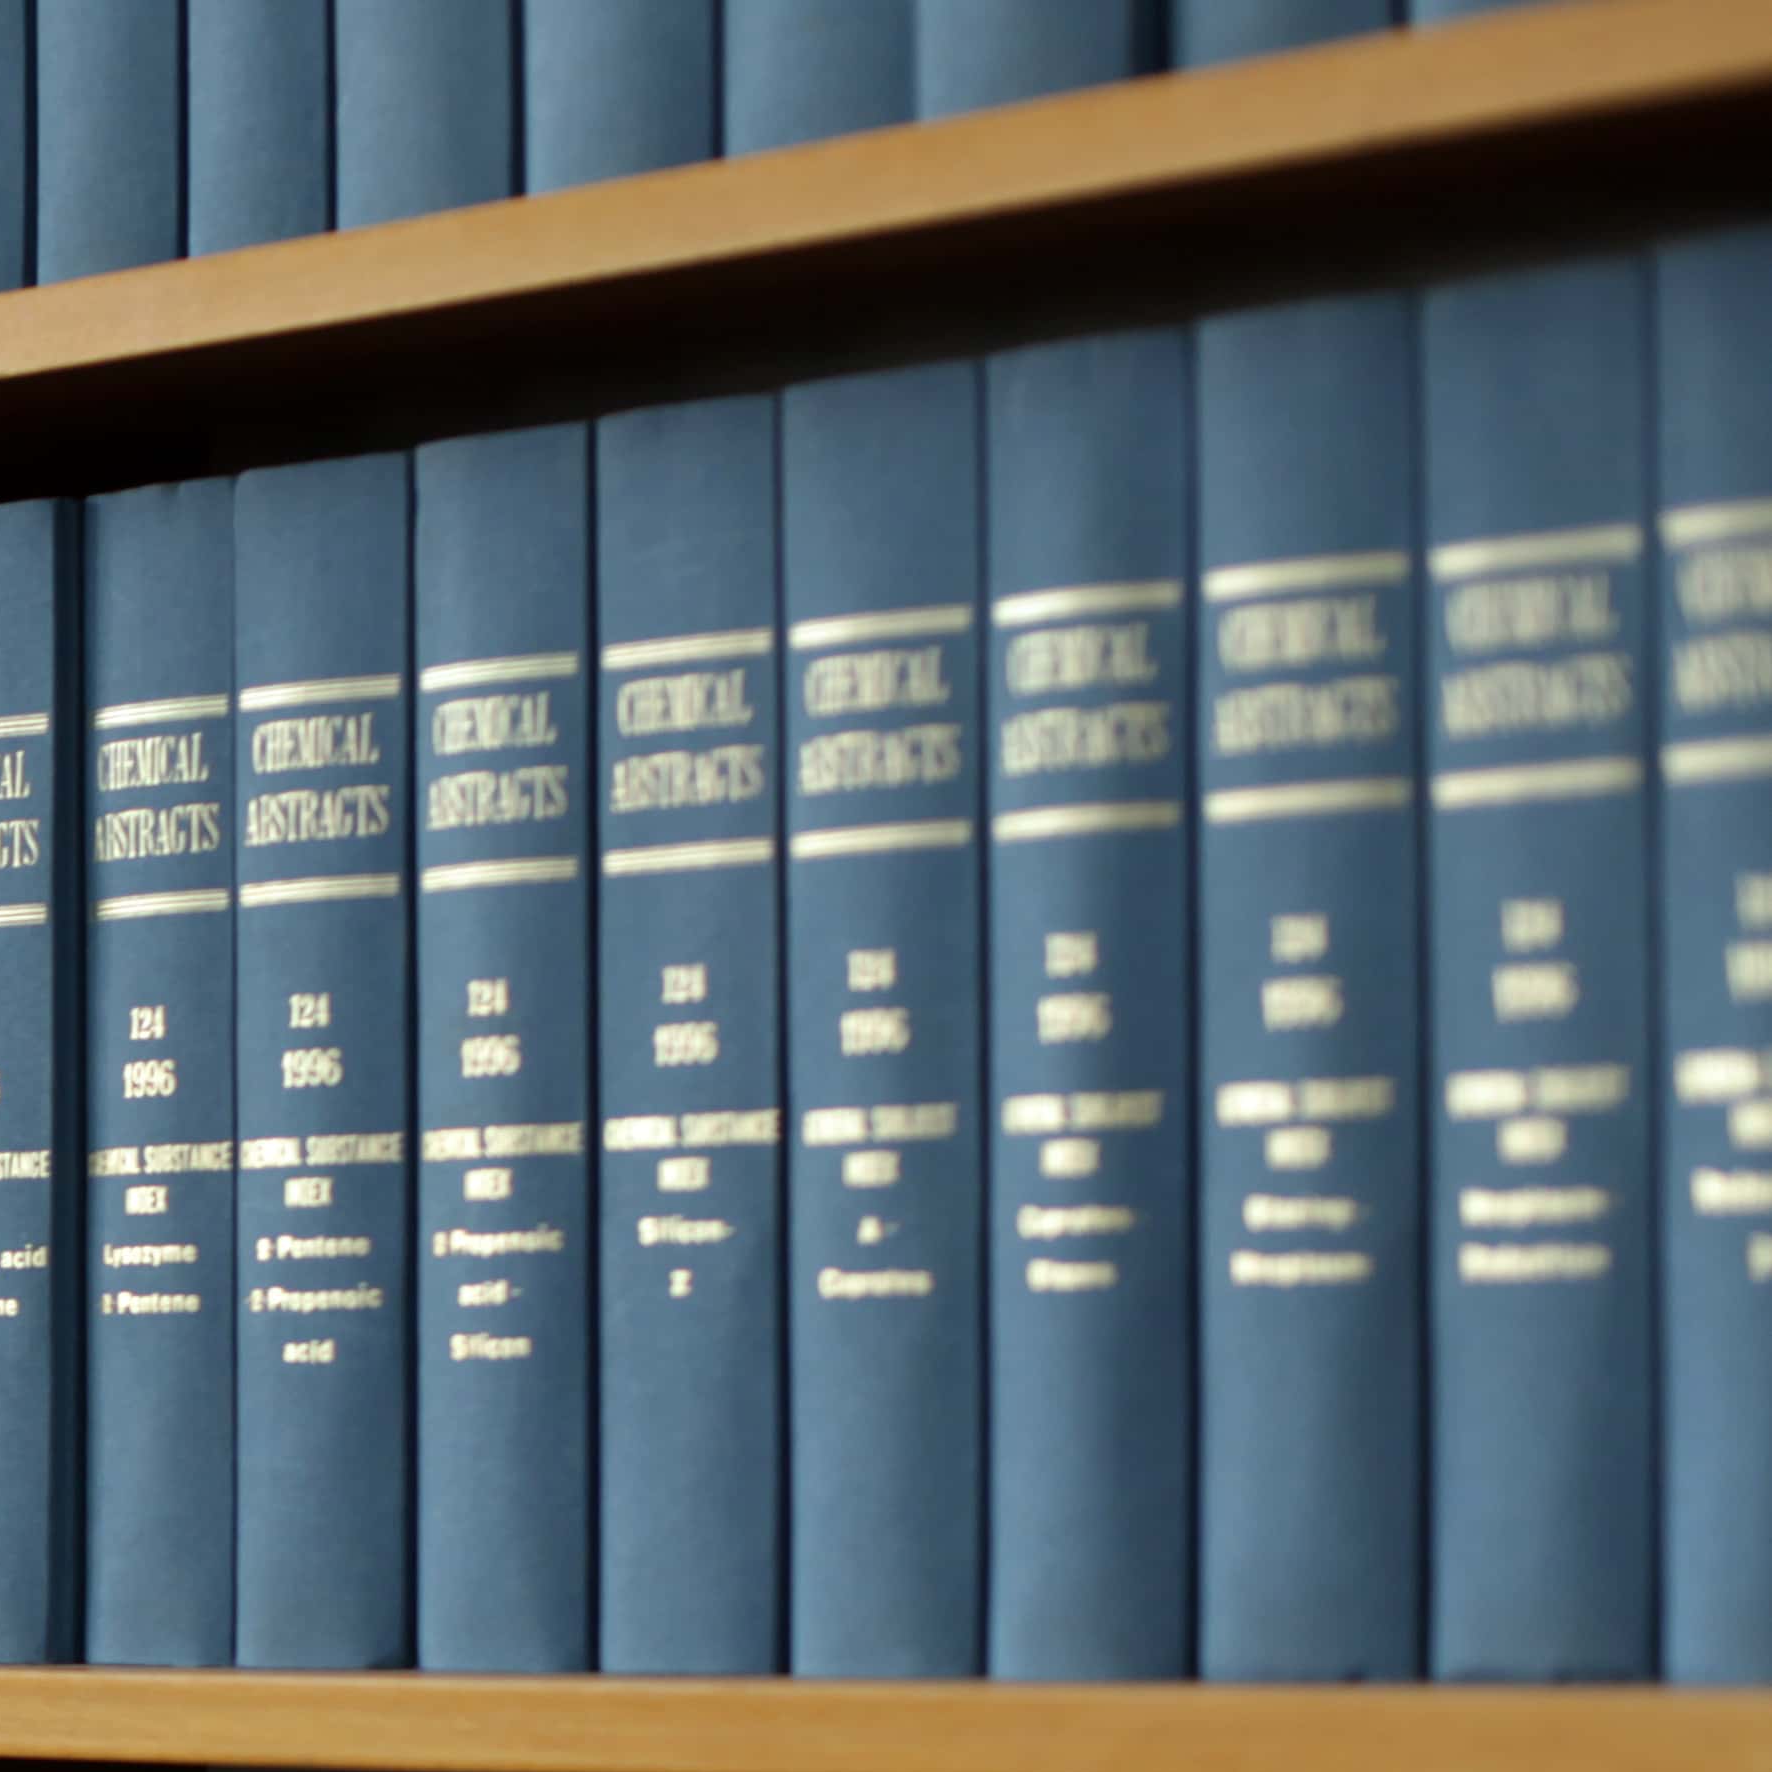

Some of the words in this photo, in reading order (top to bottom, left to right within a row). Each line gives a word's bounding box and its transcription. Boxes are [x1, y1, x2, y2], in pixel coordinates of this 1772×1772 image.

[253, 713, 380, 774] CHEMICAL
[432, 692, 558, 756] CHEMICAL
[97, 732, 210, 792] CHEMICAL
[245, 785, 390, 847] ABSTRACTS
[426, 766, 568, 831] ABSTRACTS
[94, 803, 222, 862] ABSTRACTS
[130, 1005, 165, 1041] 124
[289, 992, 331, 1029] 124
[123, 1060, 177, 1099] 1996
[281, 1048, 344, 1088] 1996
[143, 1141, 233, 1175] SUBSTANCE
[0, 1244, 49, 1269] acid
[281, 1339, 336, 1364] acid
[450, 1333, 532, 1361] Silicon
